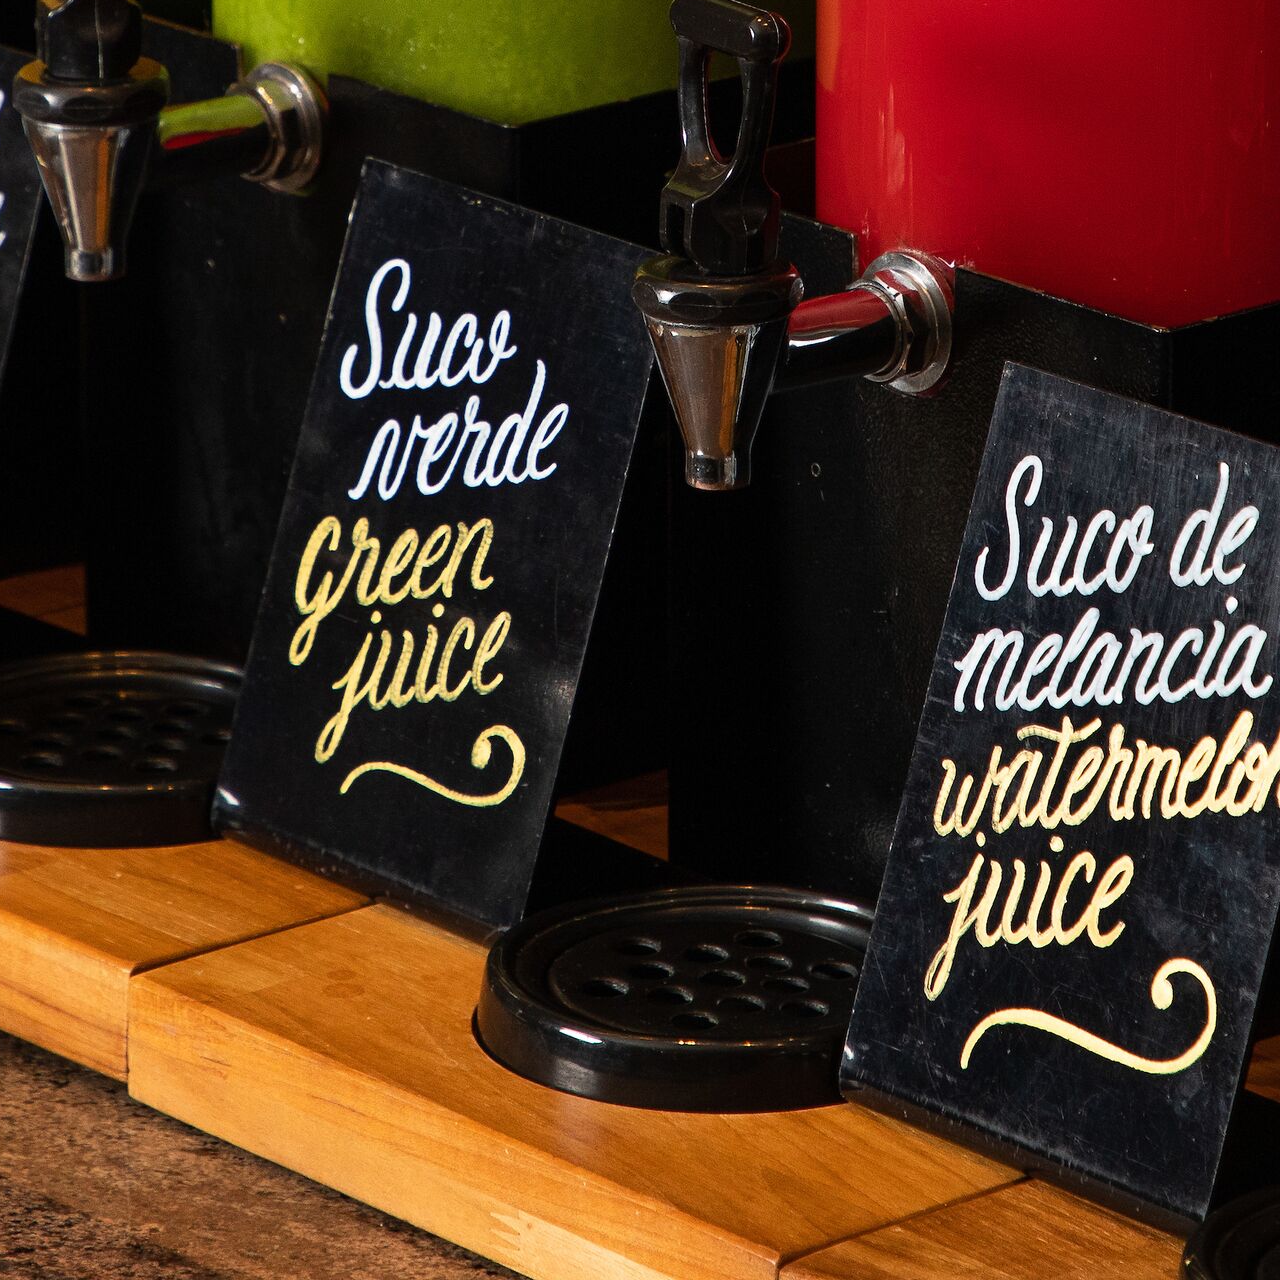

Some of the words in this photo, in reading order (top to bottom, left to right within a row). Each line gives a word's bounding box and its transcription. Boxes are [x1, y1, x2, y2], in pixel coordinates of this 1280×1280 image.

[340, 258, 518, 399] Suco
[348, 359, 569, 501] verde
[975, 455, 1154, 601] Suco
[1170, 462, 1260, 588] de
[316, 604, 511, 764] juice
[952, 597, 1273, 712] melancia
[924, 834, 1134, 1001] juice
